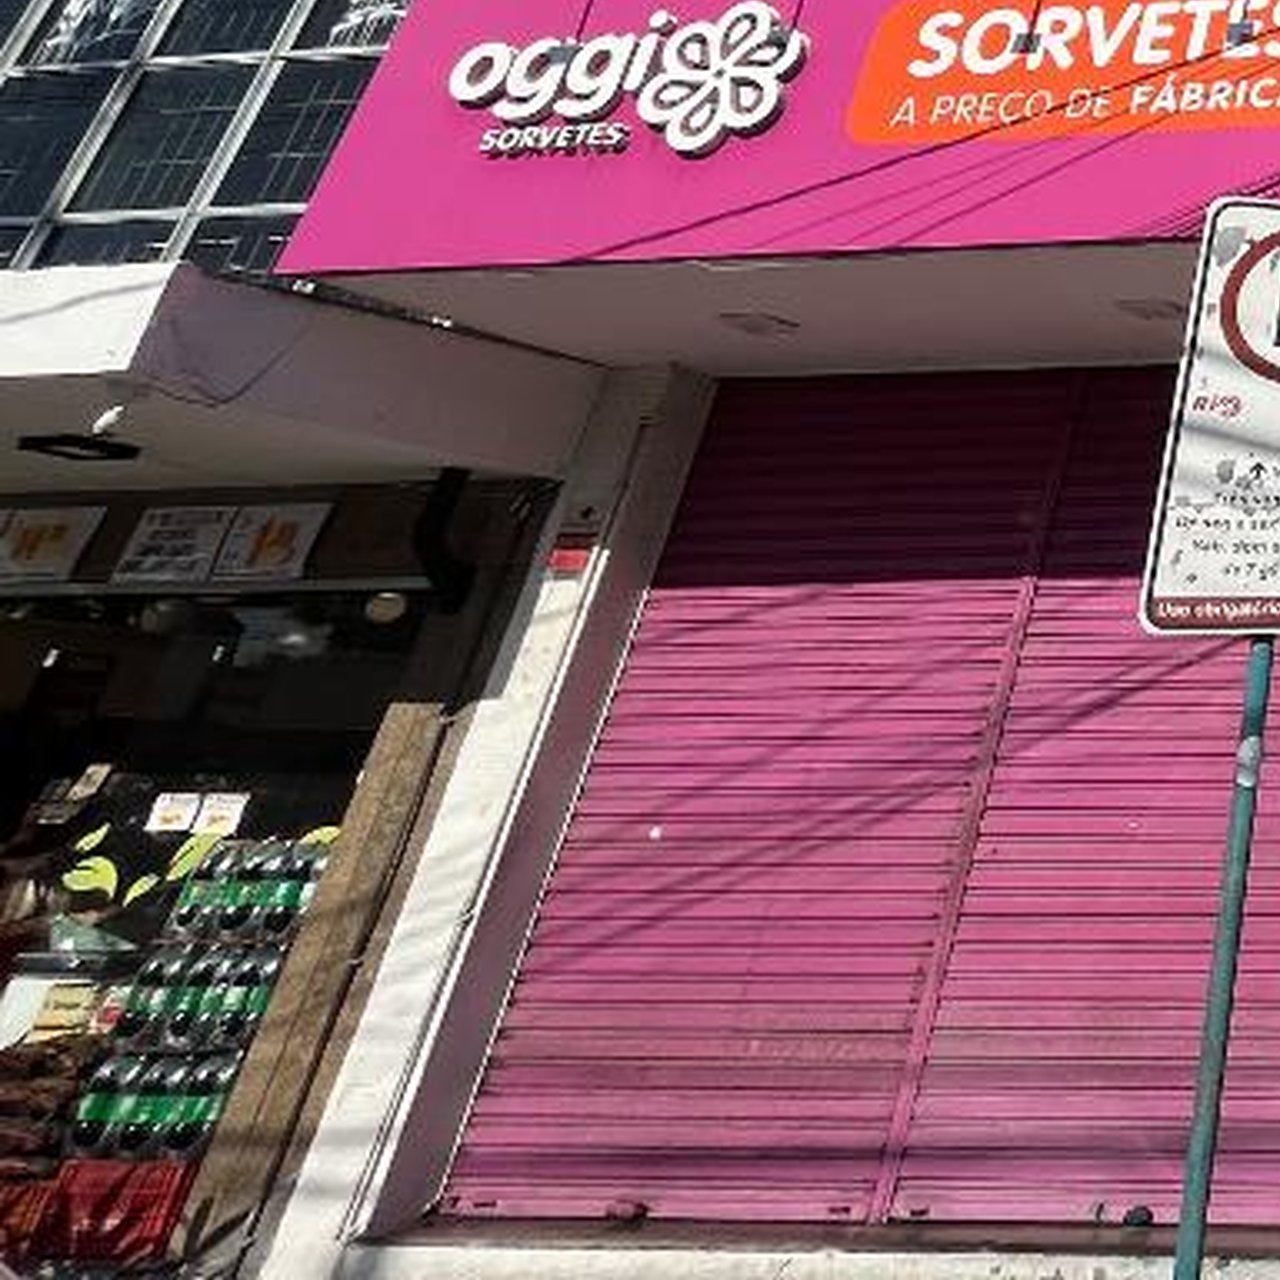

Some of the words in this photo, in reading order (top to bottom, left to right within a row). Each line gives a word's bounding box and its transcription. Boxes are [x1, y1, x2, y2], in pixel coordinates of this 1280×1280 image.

[449, 10, 677, 121] oggi
[889, 96, 916, 128] A
[1065, 87, 1111, 119] DE
[480, 122, 628, 152] SORVETES
